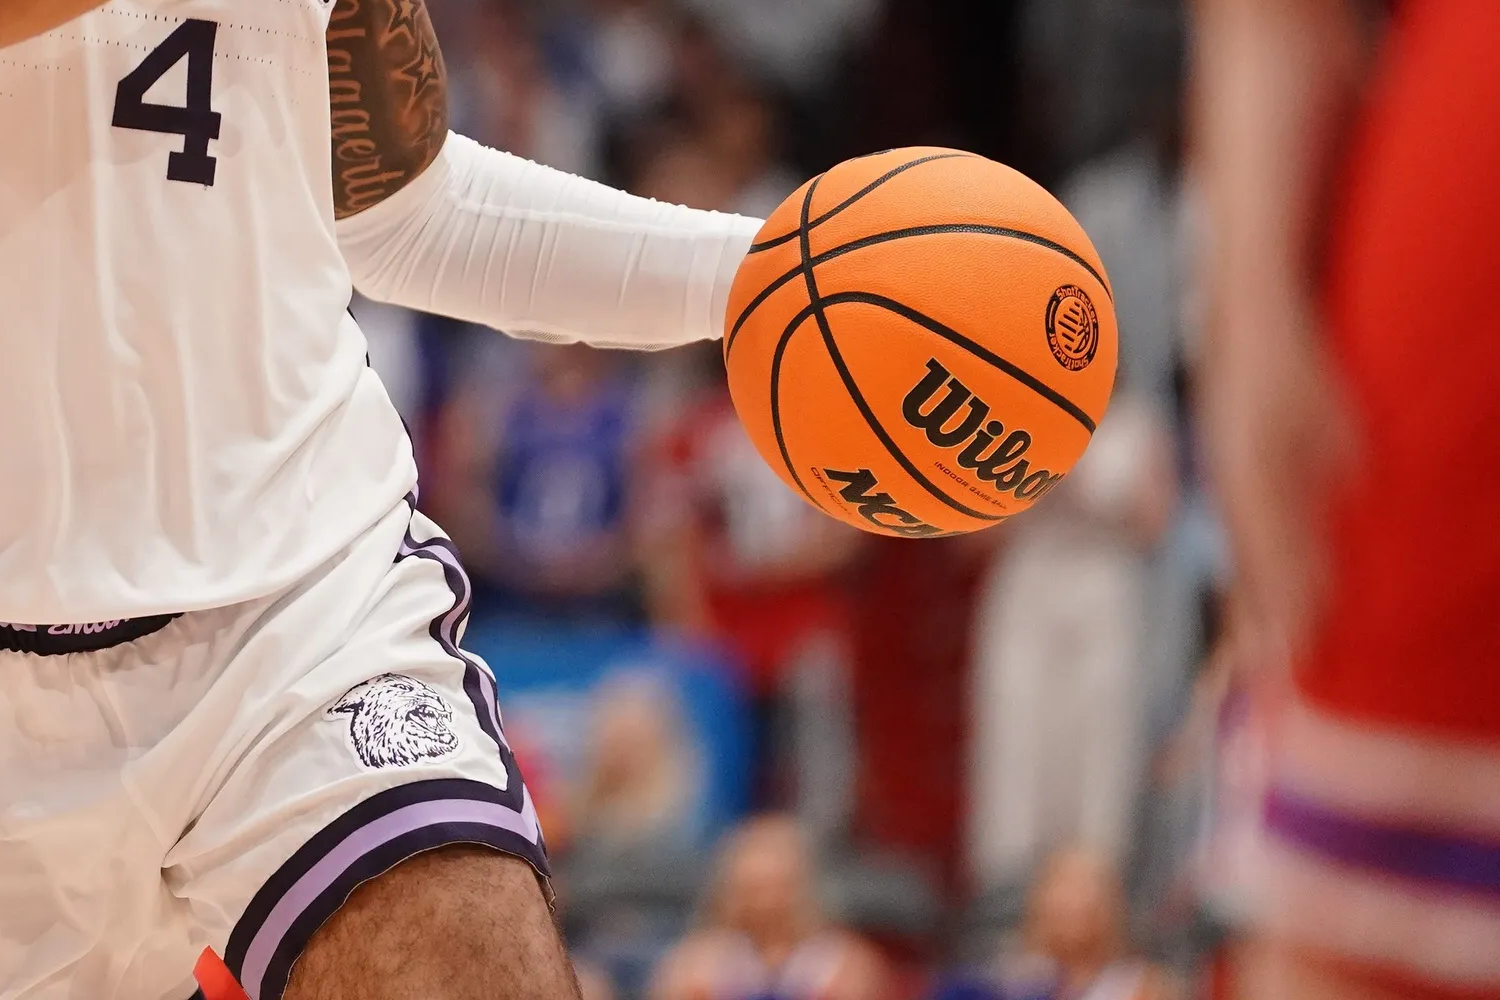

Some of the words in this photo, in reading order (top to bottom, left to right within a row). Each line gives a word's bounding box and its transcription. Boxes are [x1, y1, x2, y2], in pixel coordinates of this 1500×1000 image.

[111, 18, 222, 186] 4
[1056, 286, 1097, 324] ShotTracker
[822, 467, 962, 538] NCA
[934, 461, 969, 488] INDOOR
[969, 486, 992, 502] GAME
